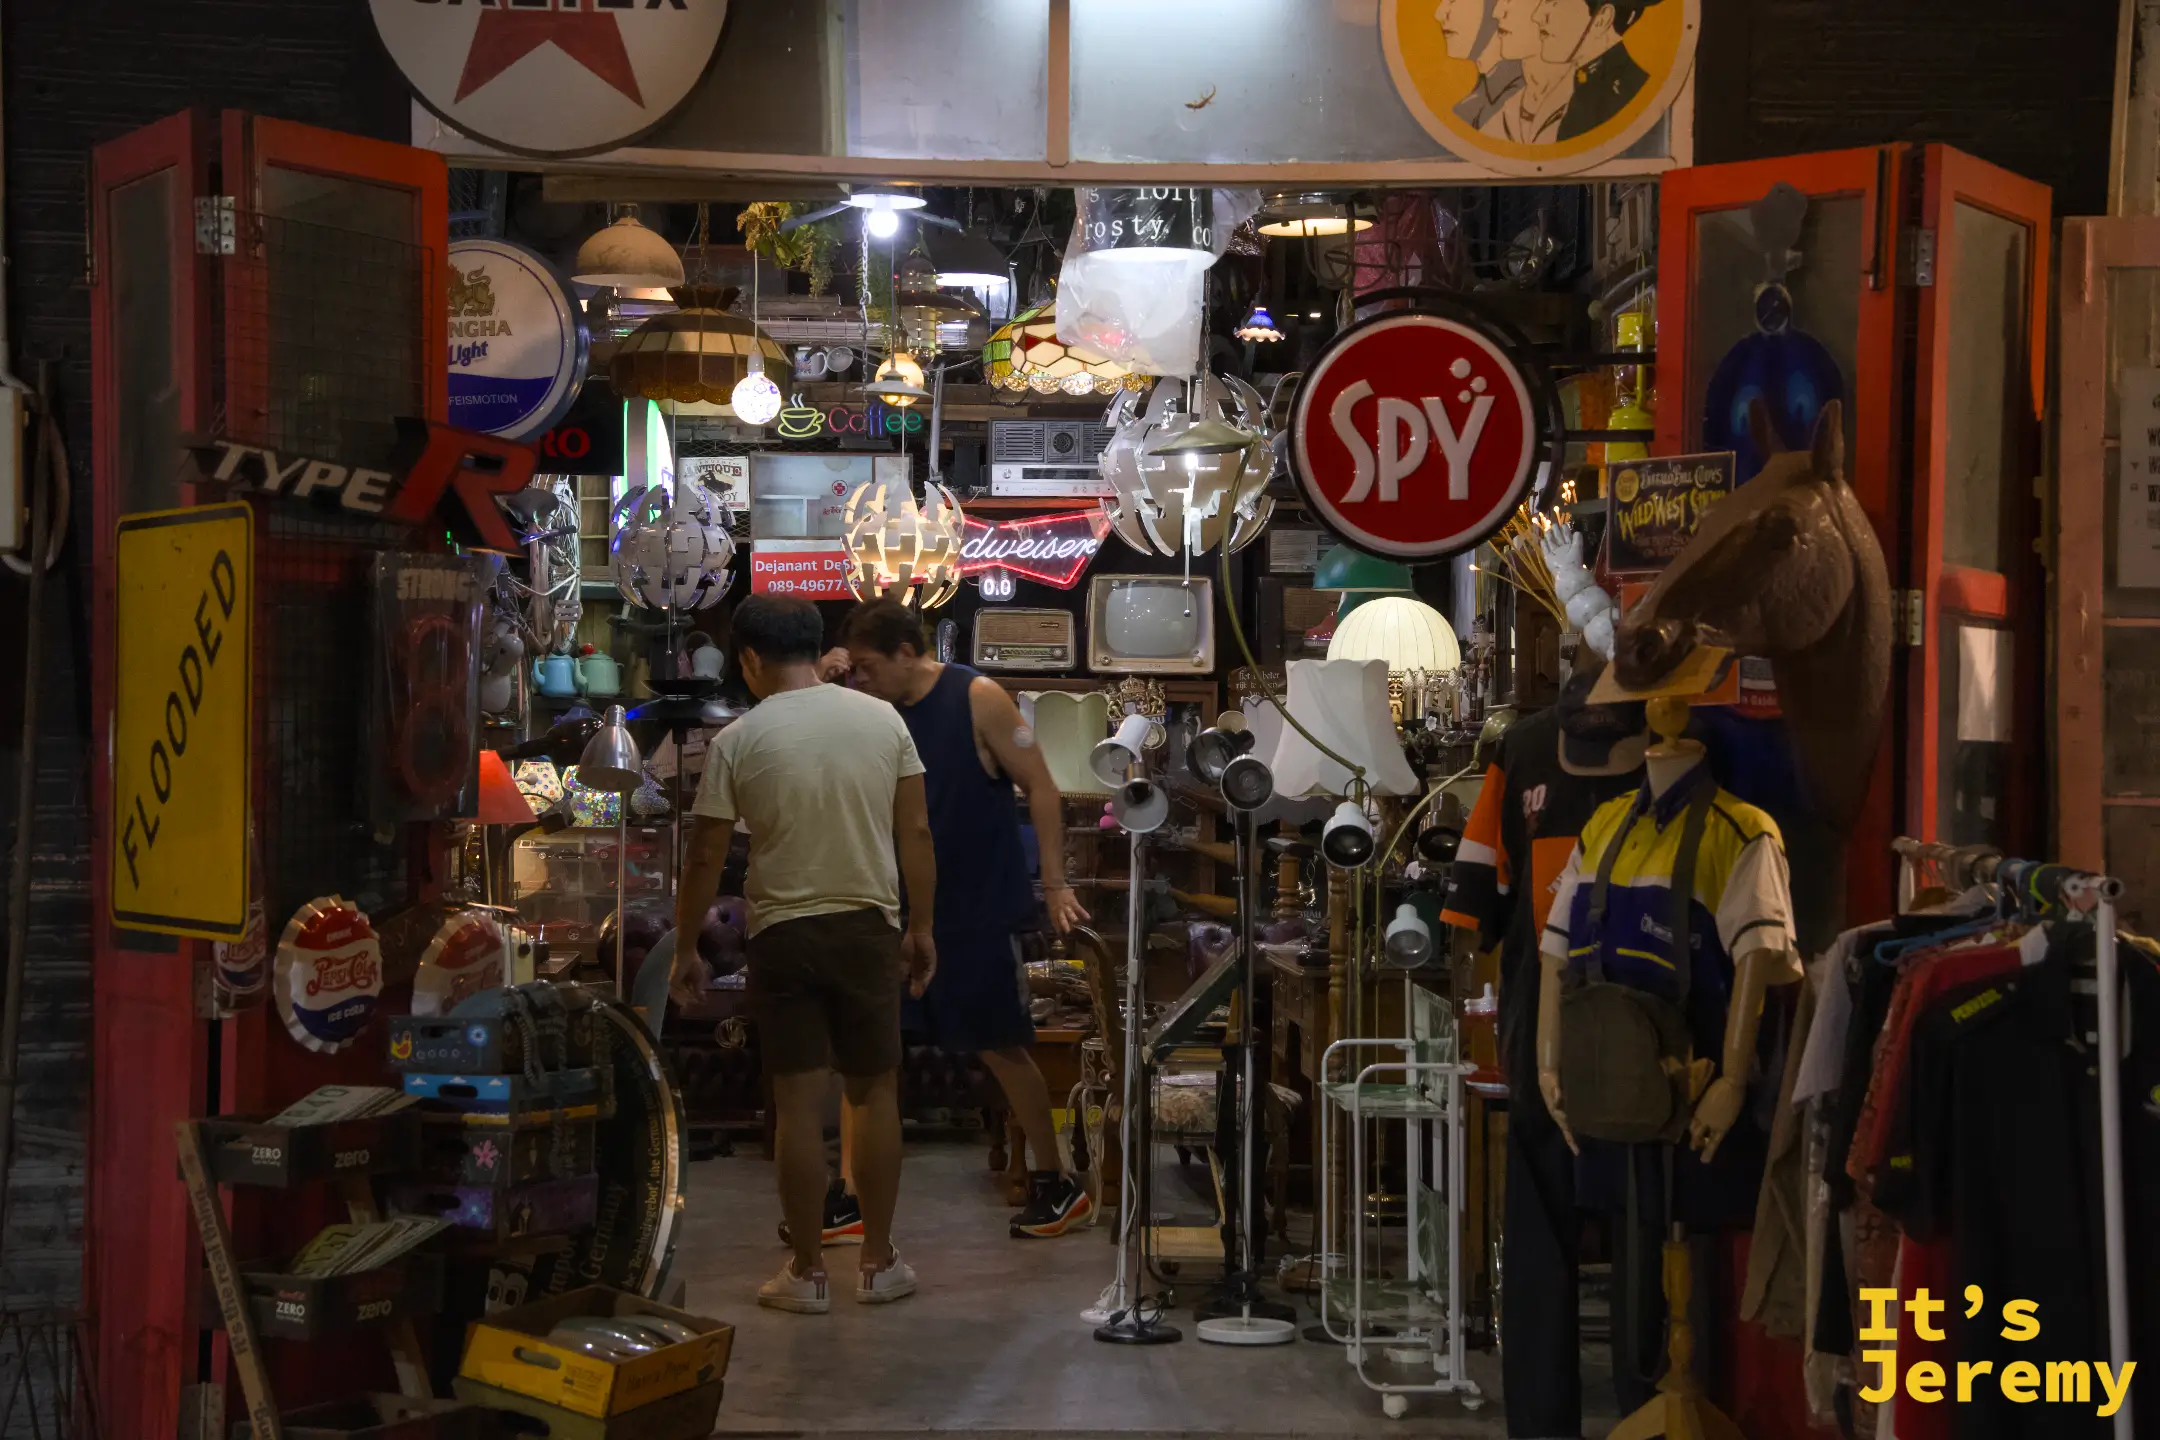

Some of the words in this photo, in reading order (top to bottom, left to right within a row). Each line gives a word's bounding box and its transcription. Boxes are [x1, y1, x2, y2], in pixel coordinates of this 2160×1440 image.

[448, 319, 513, 338] NGHA
[829, 402, 922, 438] Coffee
[1330, 378, 1496, 504] SPY
[213, 439, 393, 513] TYPE
[388, 422, 538, 556] R
[961, 526, 1098, 559] dweiser
[755, 560, 818, 575] Dejanant
[983, 578, 1011, 596] 0.0
[121, 548, 237, 891] FLOODED
[251, 1146, 282, 1160] ZERO
[334, 1148, 371, 1168] zero
[276, 1300, 306, 1317] ZERO
[356, 1299, 393, 1321] zero
